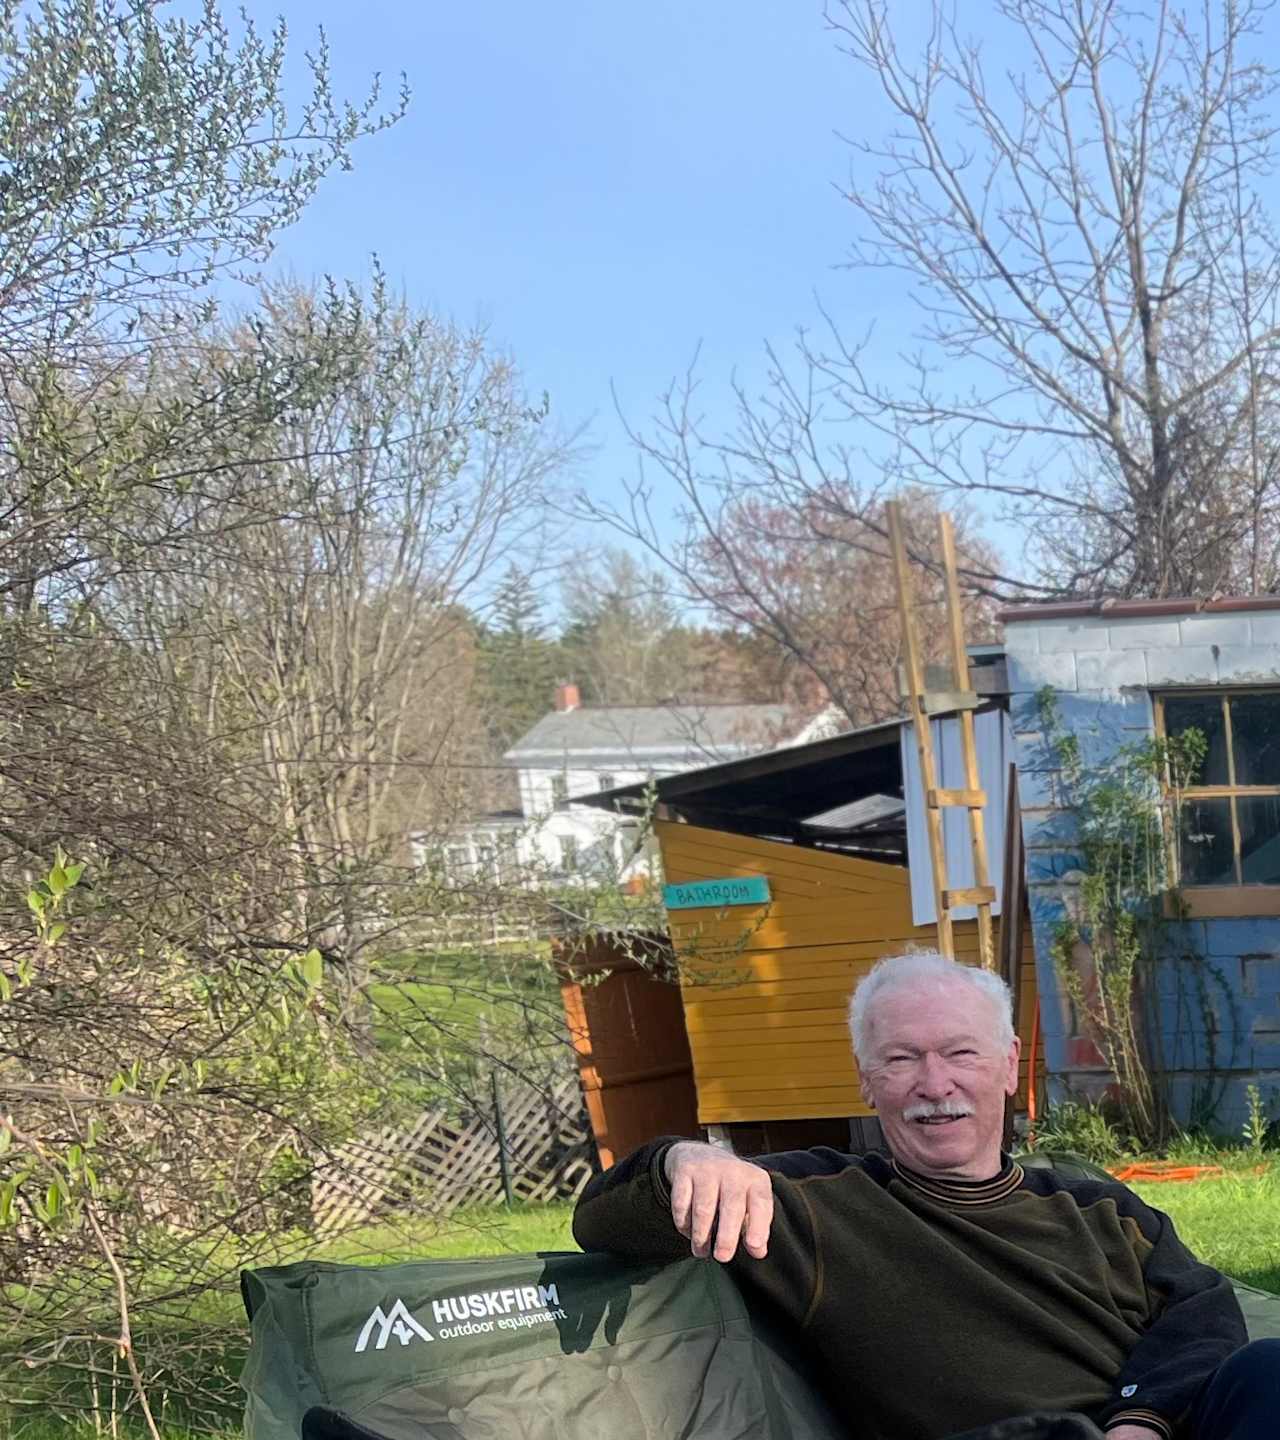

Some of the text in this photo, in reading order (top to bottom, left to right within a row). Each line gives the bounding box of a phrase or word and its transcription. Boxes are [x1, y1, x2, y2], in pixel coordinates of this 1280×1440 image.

[675, 885, 751, 905] BATHROOM
[432, 1283, 560, 1323] HUSKFIRM
[439, 1308, 569, 1340] outdoor equipment
